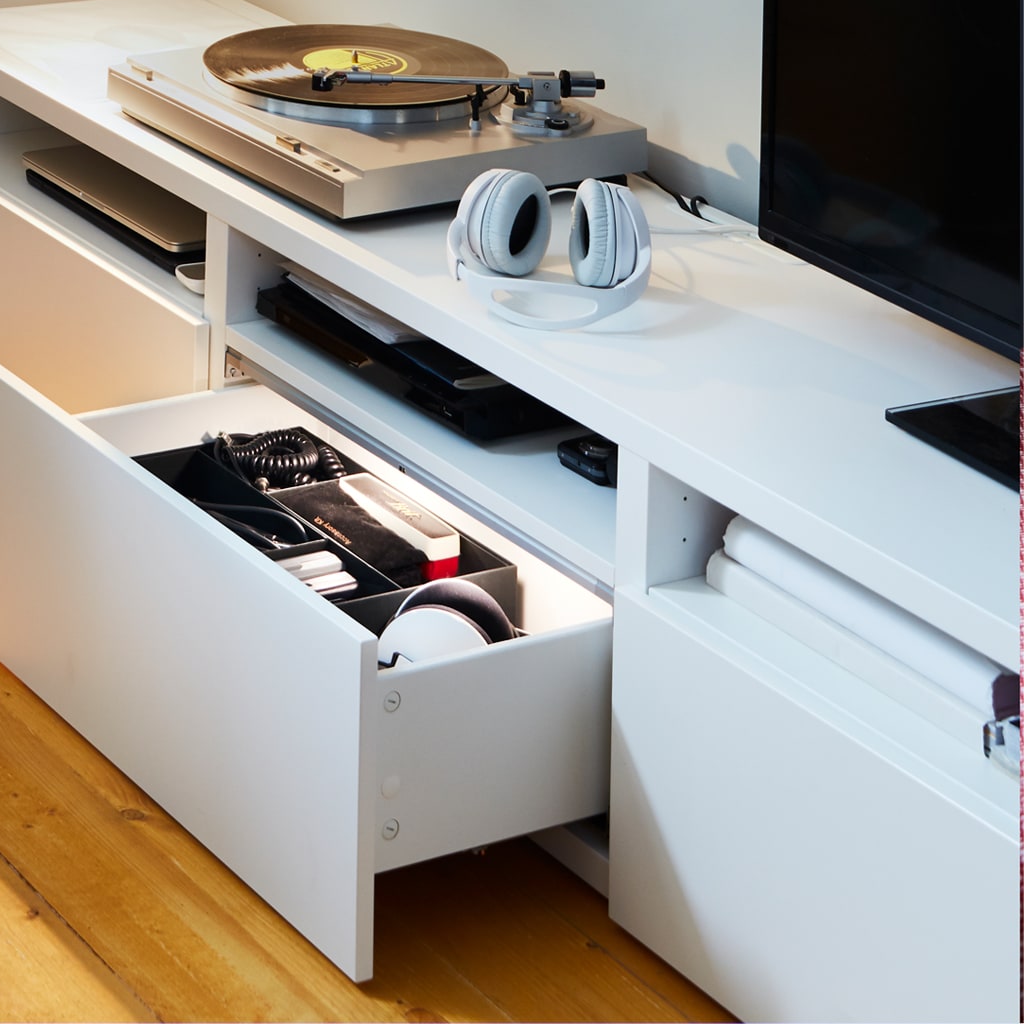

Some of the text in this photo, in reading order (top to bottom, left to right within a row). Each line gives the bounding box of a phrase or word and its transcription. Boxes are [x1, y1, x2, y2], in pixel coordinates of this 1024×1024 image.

[359, 58, 397, 72] ATLAN
[313, 516, 352, 545] Accessory Kit
